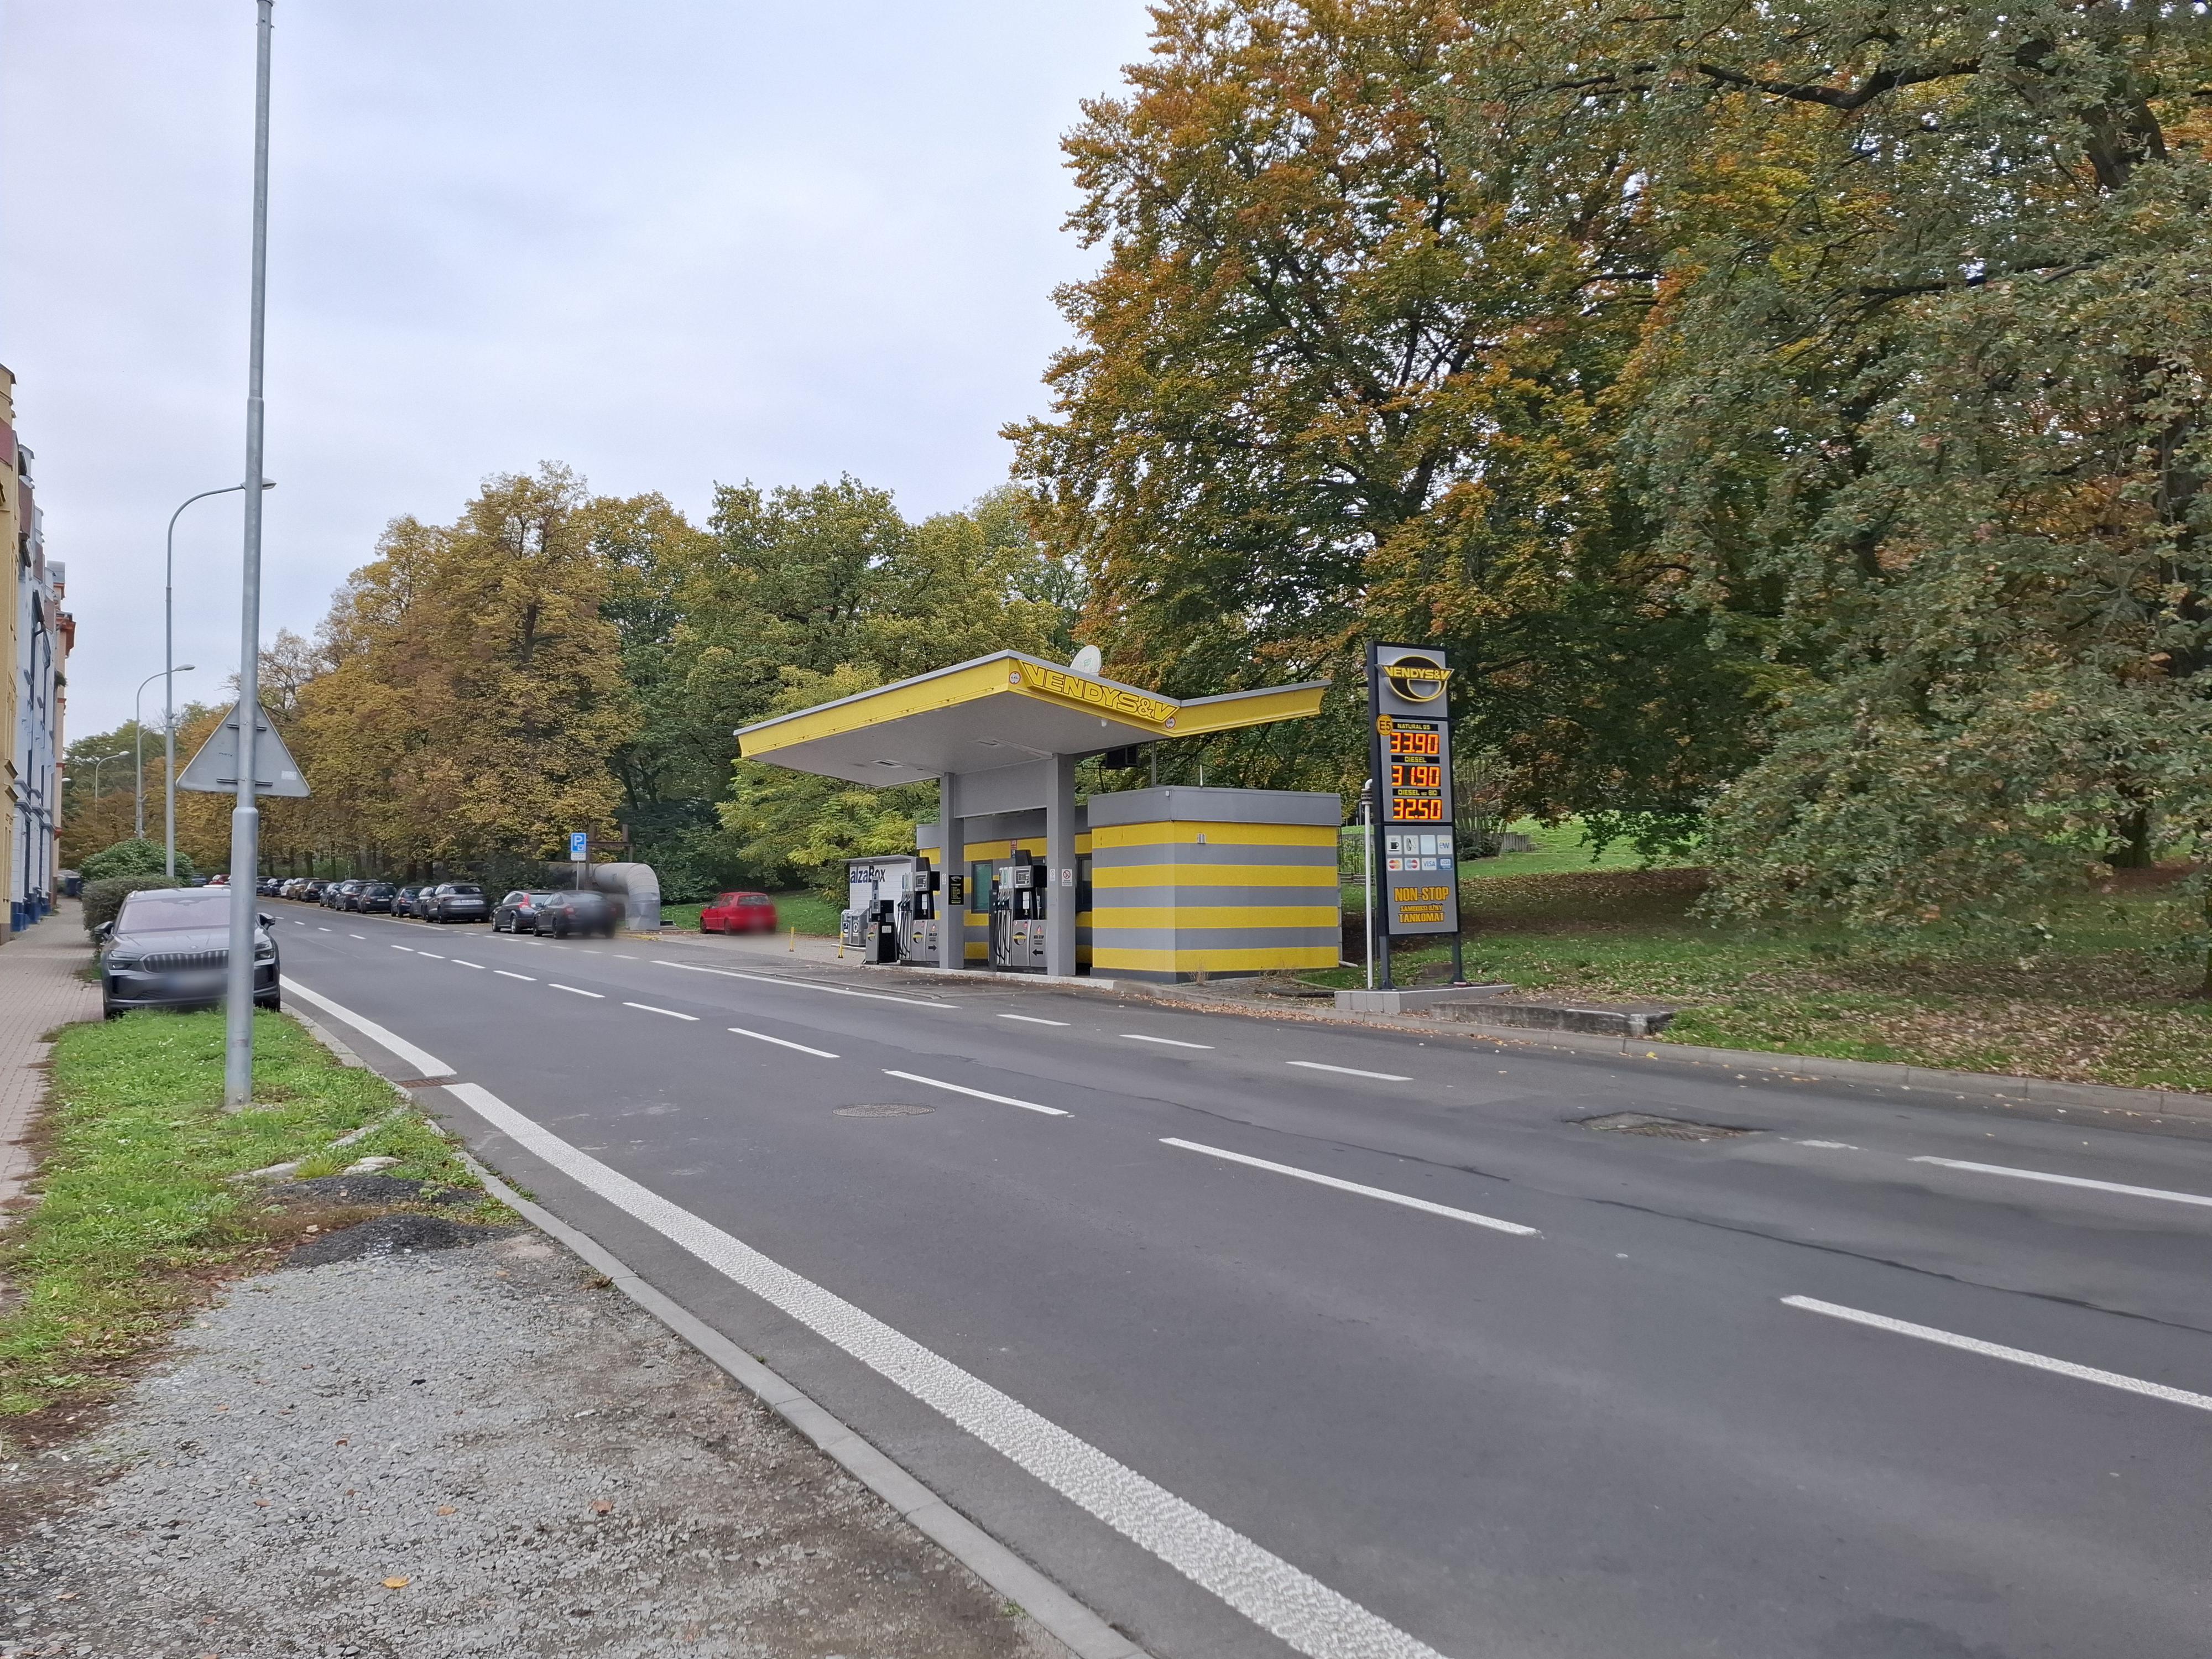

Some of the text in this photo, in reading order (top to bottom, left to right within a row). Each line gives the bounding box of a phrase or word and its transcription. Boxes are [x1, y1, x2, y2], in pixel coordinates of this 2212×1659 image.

[1383, 666, 1451, 680] VENDYS&V
[1023, 662, 1178, 721] VENDYS&V
[1380, 720, 1391, 731] E5
[574, 835, 583, 846] P
[1394, 886, 1449, 901] NON-STOP
[1398, 912, 1444, 923] TANKOMAT
